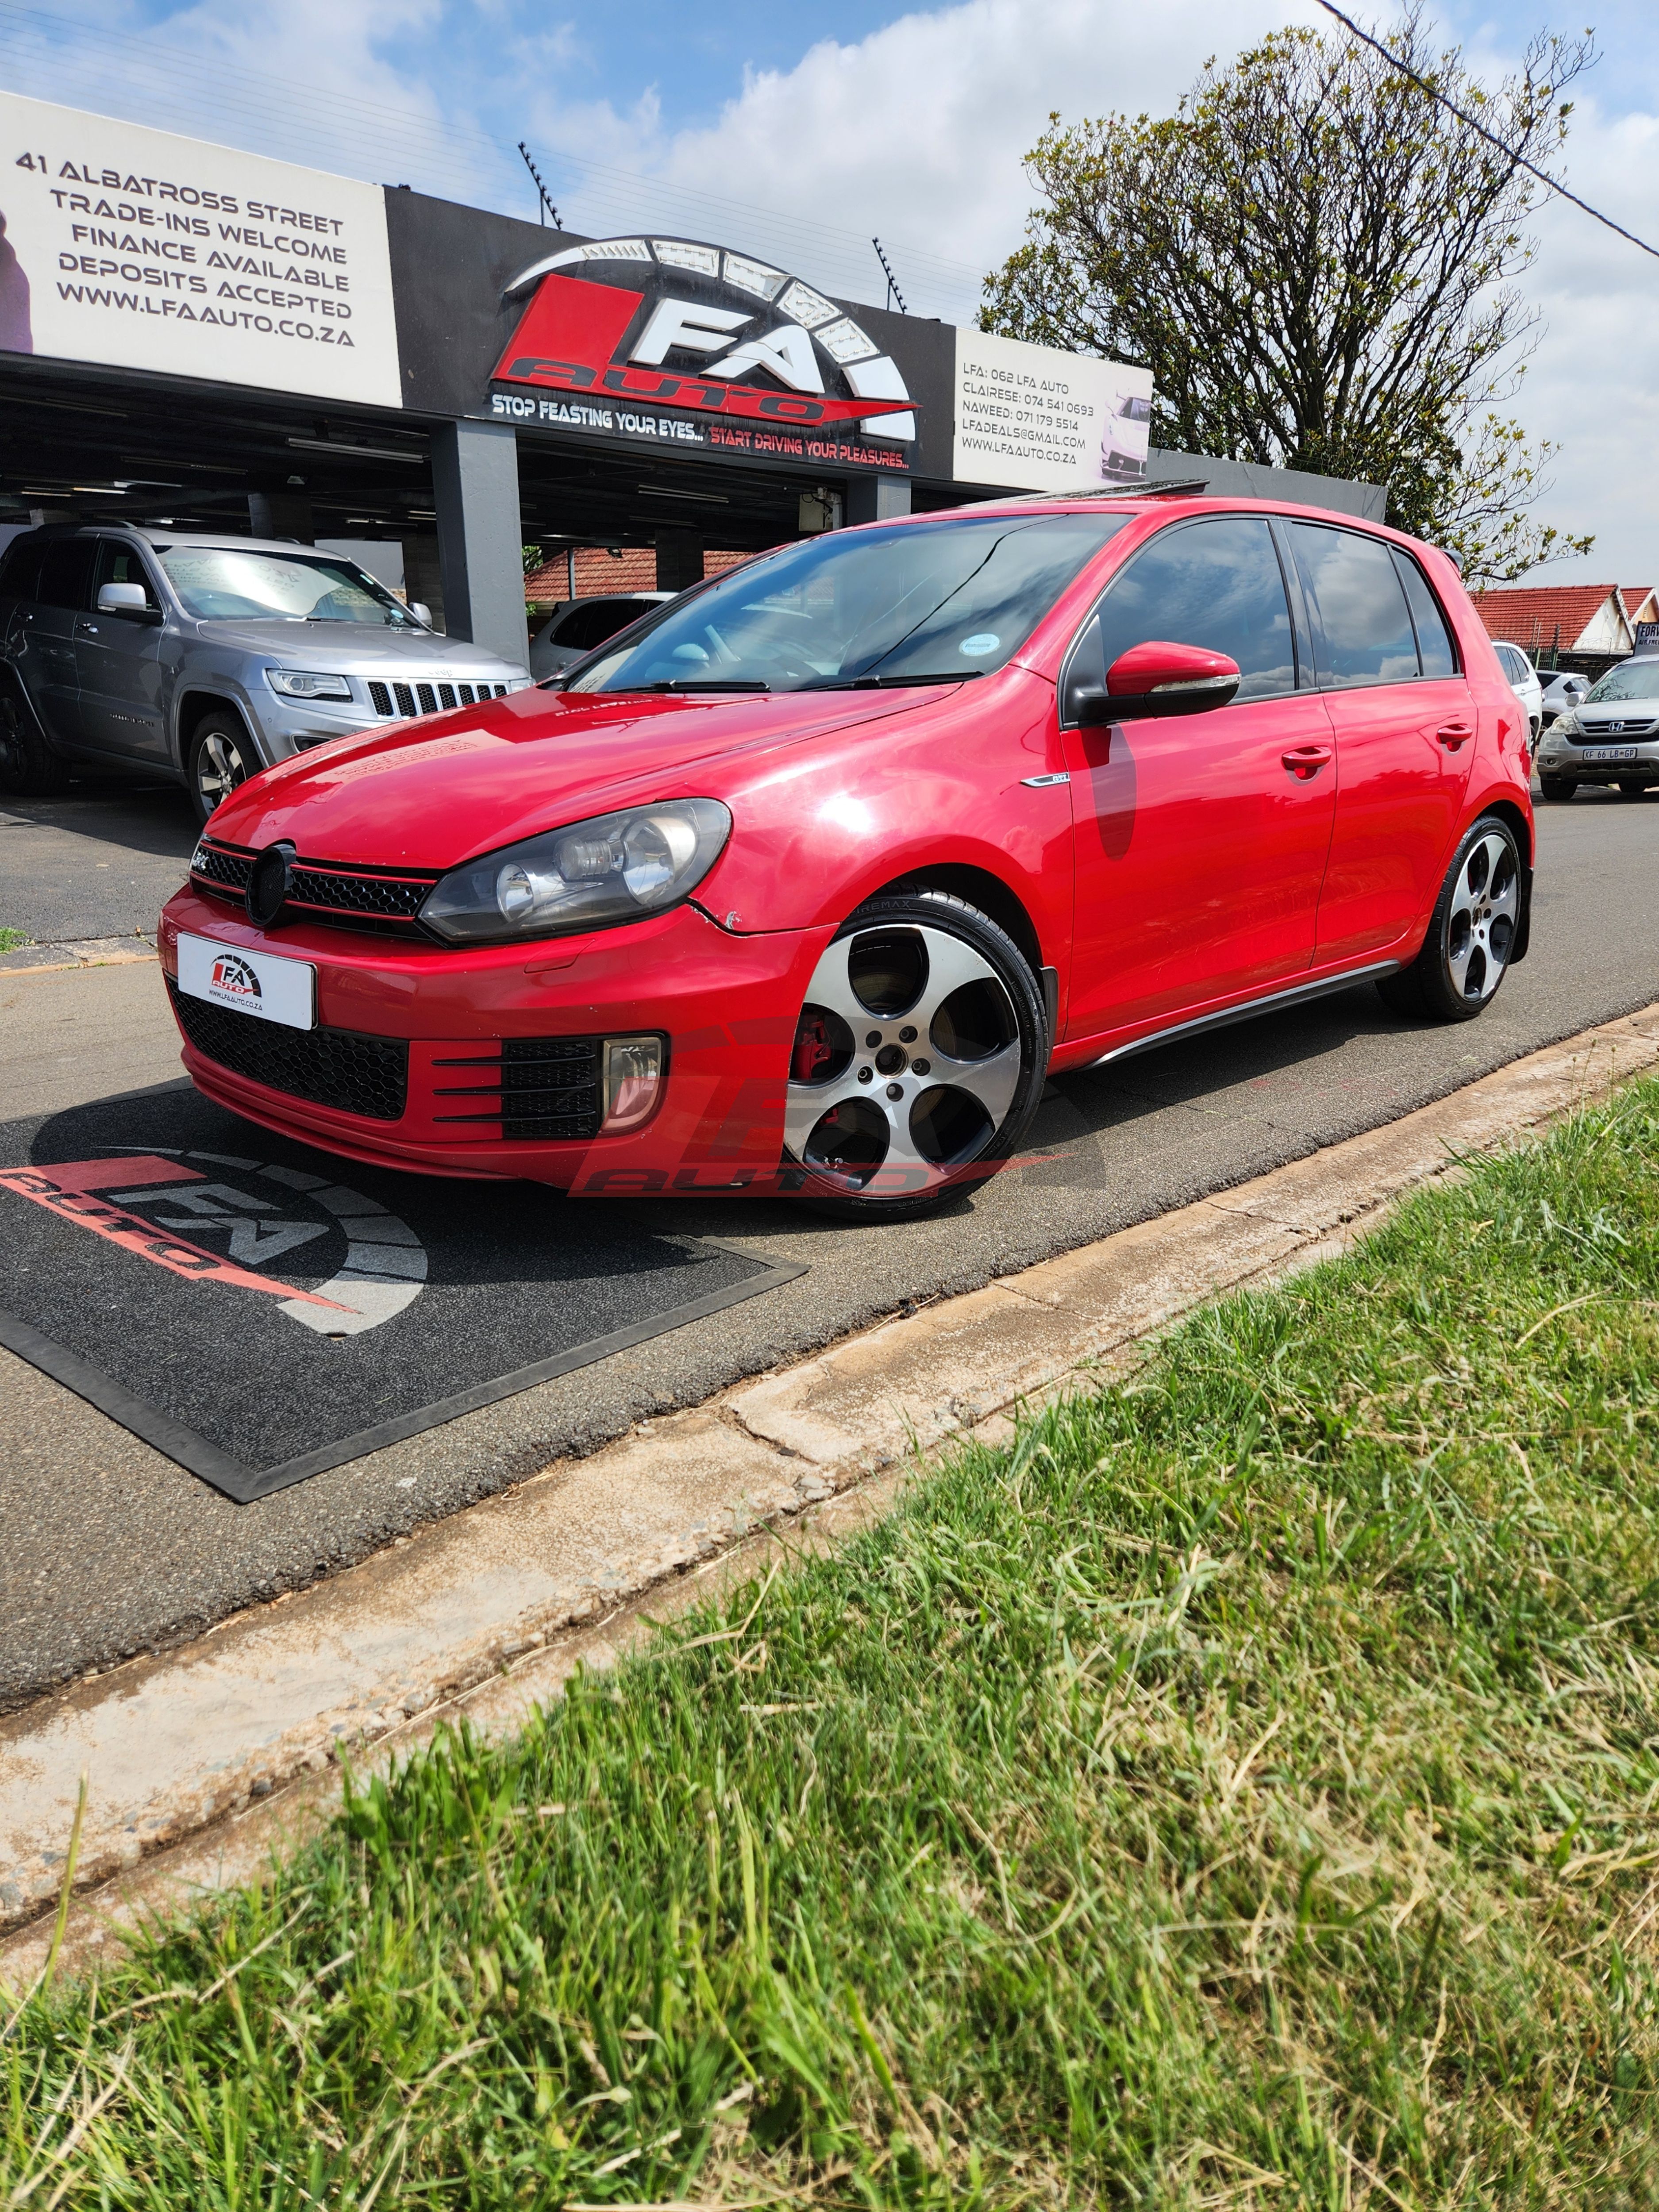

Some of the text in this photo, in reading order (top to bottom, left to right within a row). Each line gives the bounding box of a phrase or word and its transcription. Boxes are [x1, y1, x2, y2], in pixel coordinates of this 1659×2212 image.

[15, 152, 344, 236] 41 ALBATROSS STREET
[50, 189, 347, 265] TRADE-INS WELCOME
[72, 223, 350, 292] FINANCE AVAILABLE
[59, 252, 352, 319] DEPOSITS ACCEPTED
[56, 282, 354, 347] WWW.LFAAUTO.CO.ZA
[507, 357, 825, 420] AUTO
[963, 362, 1069, 394] LFA: 062 LFA AUTO
[963, 382, 1094, 416] CLAIRESE: 074 541 0693
[492, 394, 909, 469] STOP FEASTING YOUR EYES... START DRIVING YOUR PLEASURES...
[962, 418, 1085, 449] LFADEALS@GMAIL.COM
[963, 400, 1078, 431] NAWEED: 071 179 5514
[962, 436, 1077, 464] WWW.LFAAUTO.CO.ZA
[1053, 774, 1066, 783] GTI
[209, 989, 262, 1011] WWW.LFAAUTO.CO.ZA
[212, 980, 244, 993] AUTO
[0, 1173, 221, 1271] AUTO
